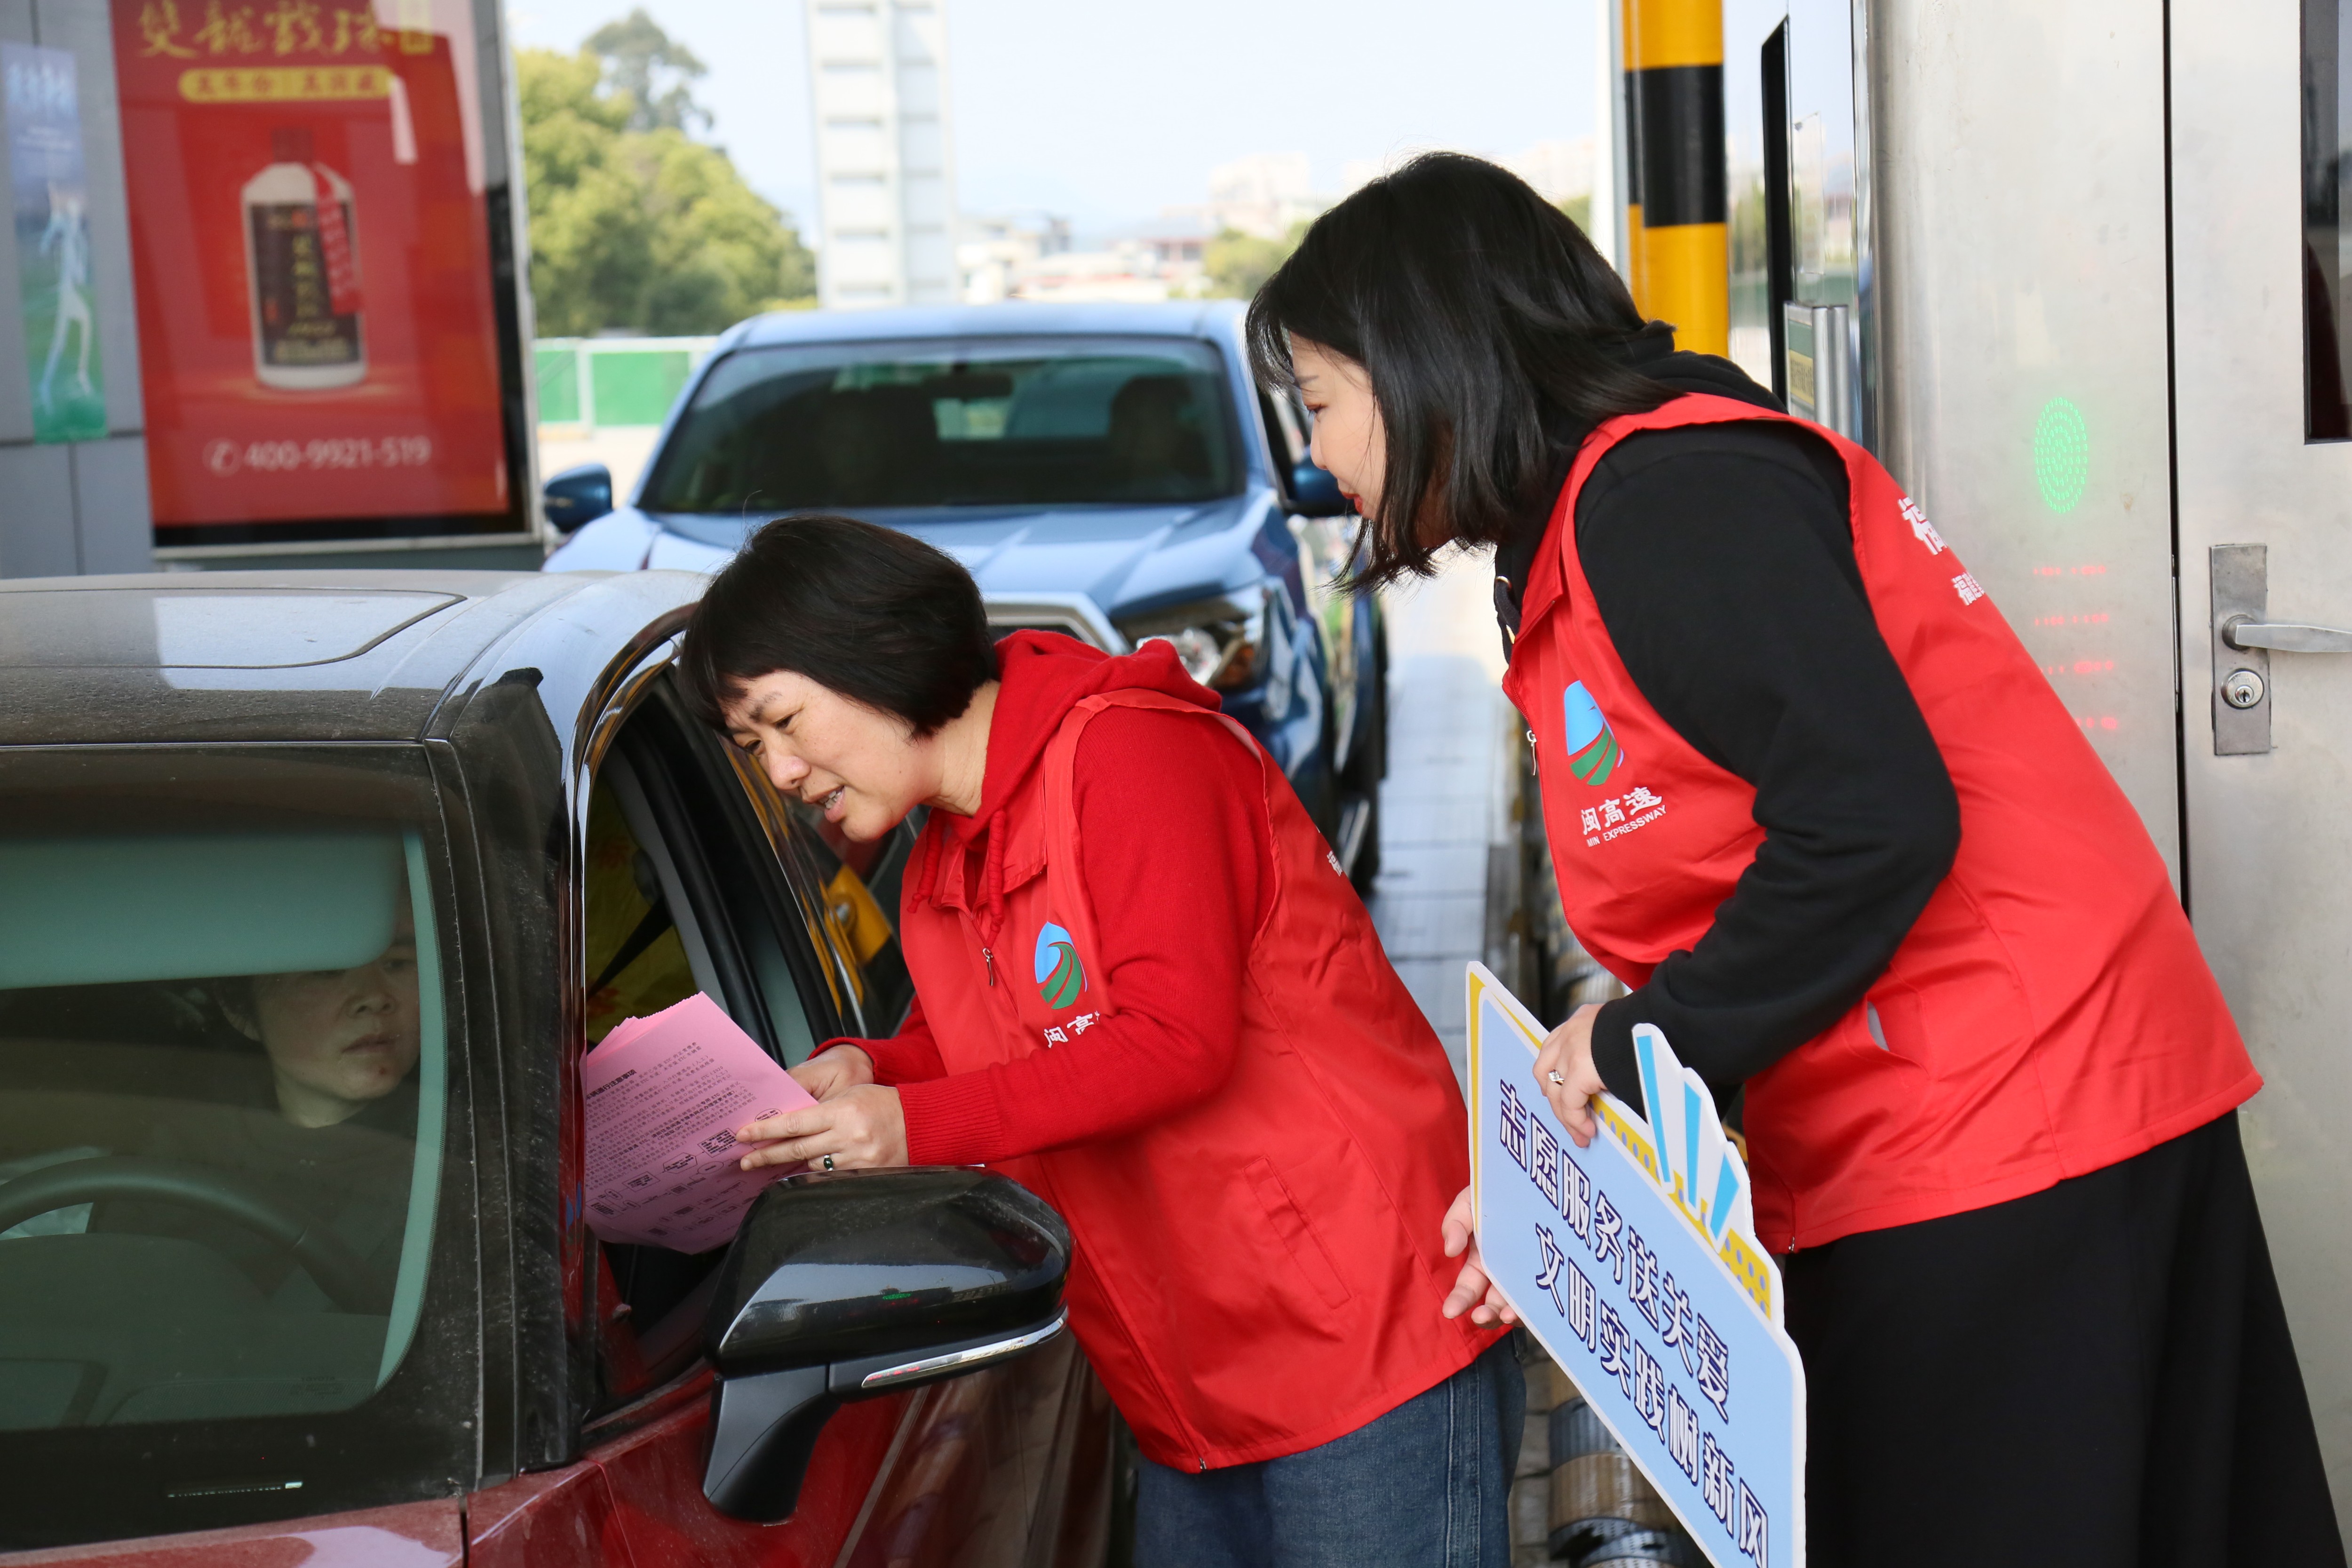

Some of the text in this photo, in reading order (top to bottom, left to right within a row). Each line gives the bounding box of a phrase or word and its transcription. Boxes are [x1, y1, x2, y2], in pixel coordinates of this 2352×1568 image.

[1581, 786, 1662, 836] 闽高速
[1586, 804, 1667, 848] MIN EXPRESSWAY
[1043, 1011, 1101, 1049] 闽高
[1499, 1079, 1730, 1424] 志愿服务送关爱
[1535, 1222, 1769, 1568] 文明实践树新风
